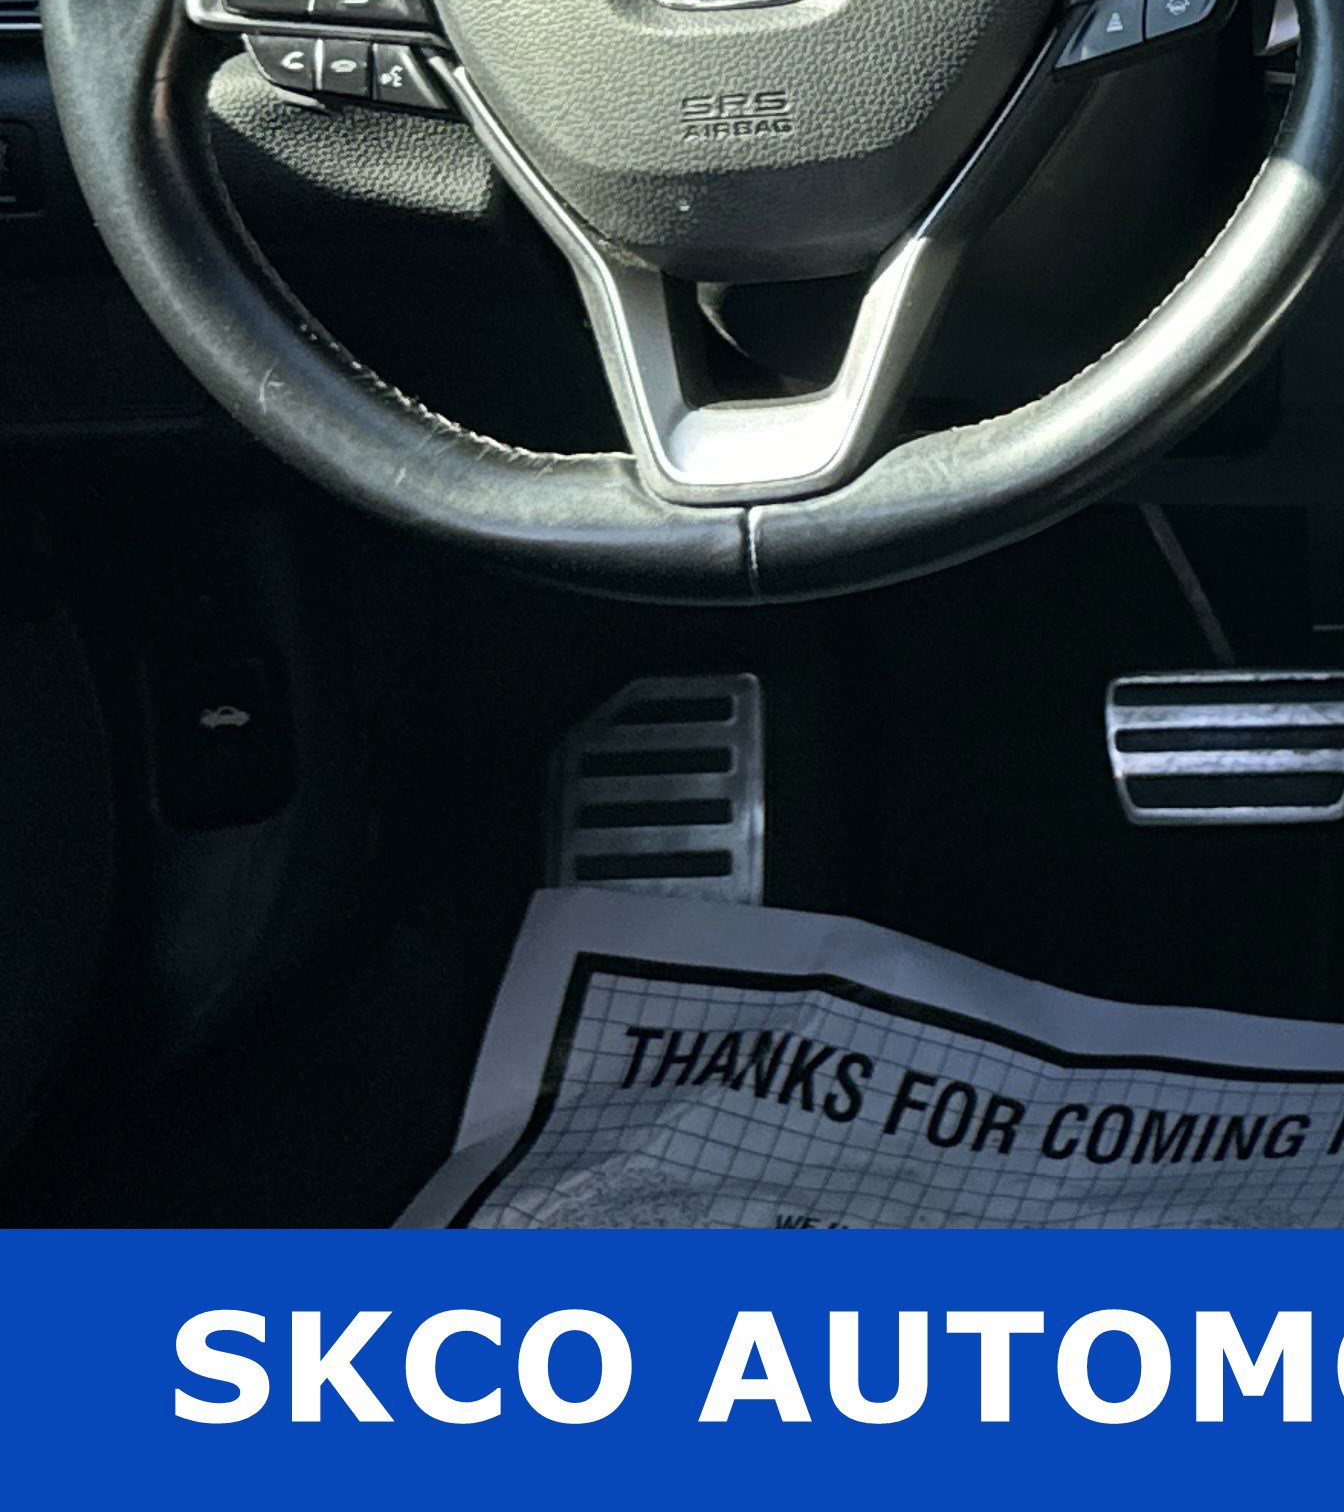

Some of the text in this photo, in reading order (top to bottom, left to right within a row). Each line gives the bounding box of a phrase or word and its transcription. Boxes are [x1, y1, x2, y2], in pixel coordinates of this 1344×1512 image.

[681, 90, 794, 117] SRS
[681, 119, 794, 140] AIRBAG
[624, 1026, 873, 1124] THANKS
[885, 1068, 1027, 1156] FOR
[1043, 1102, 1306, 1165] COMING
